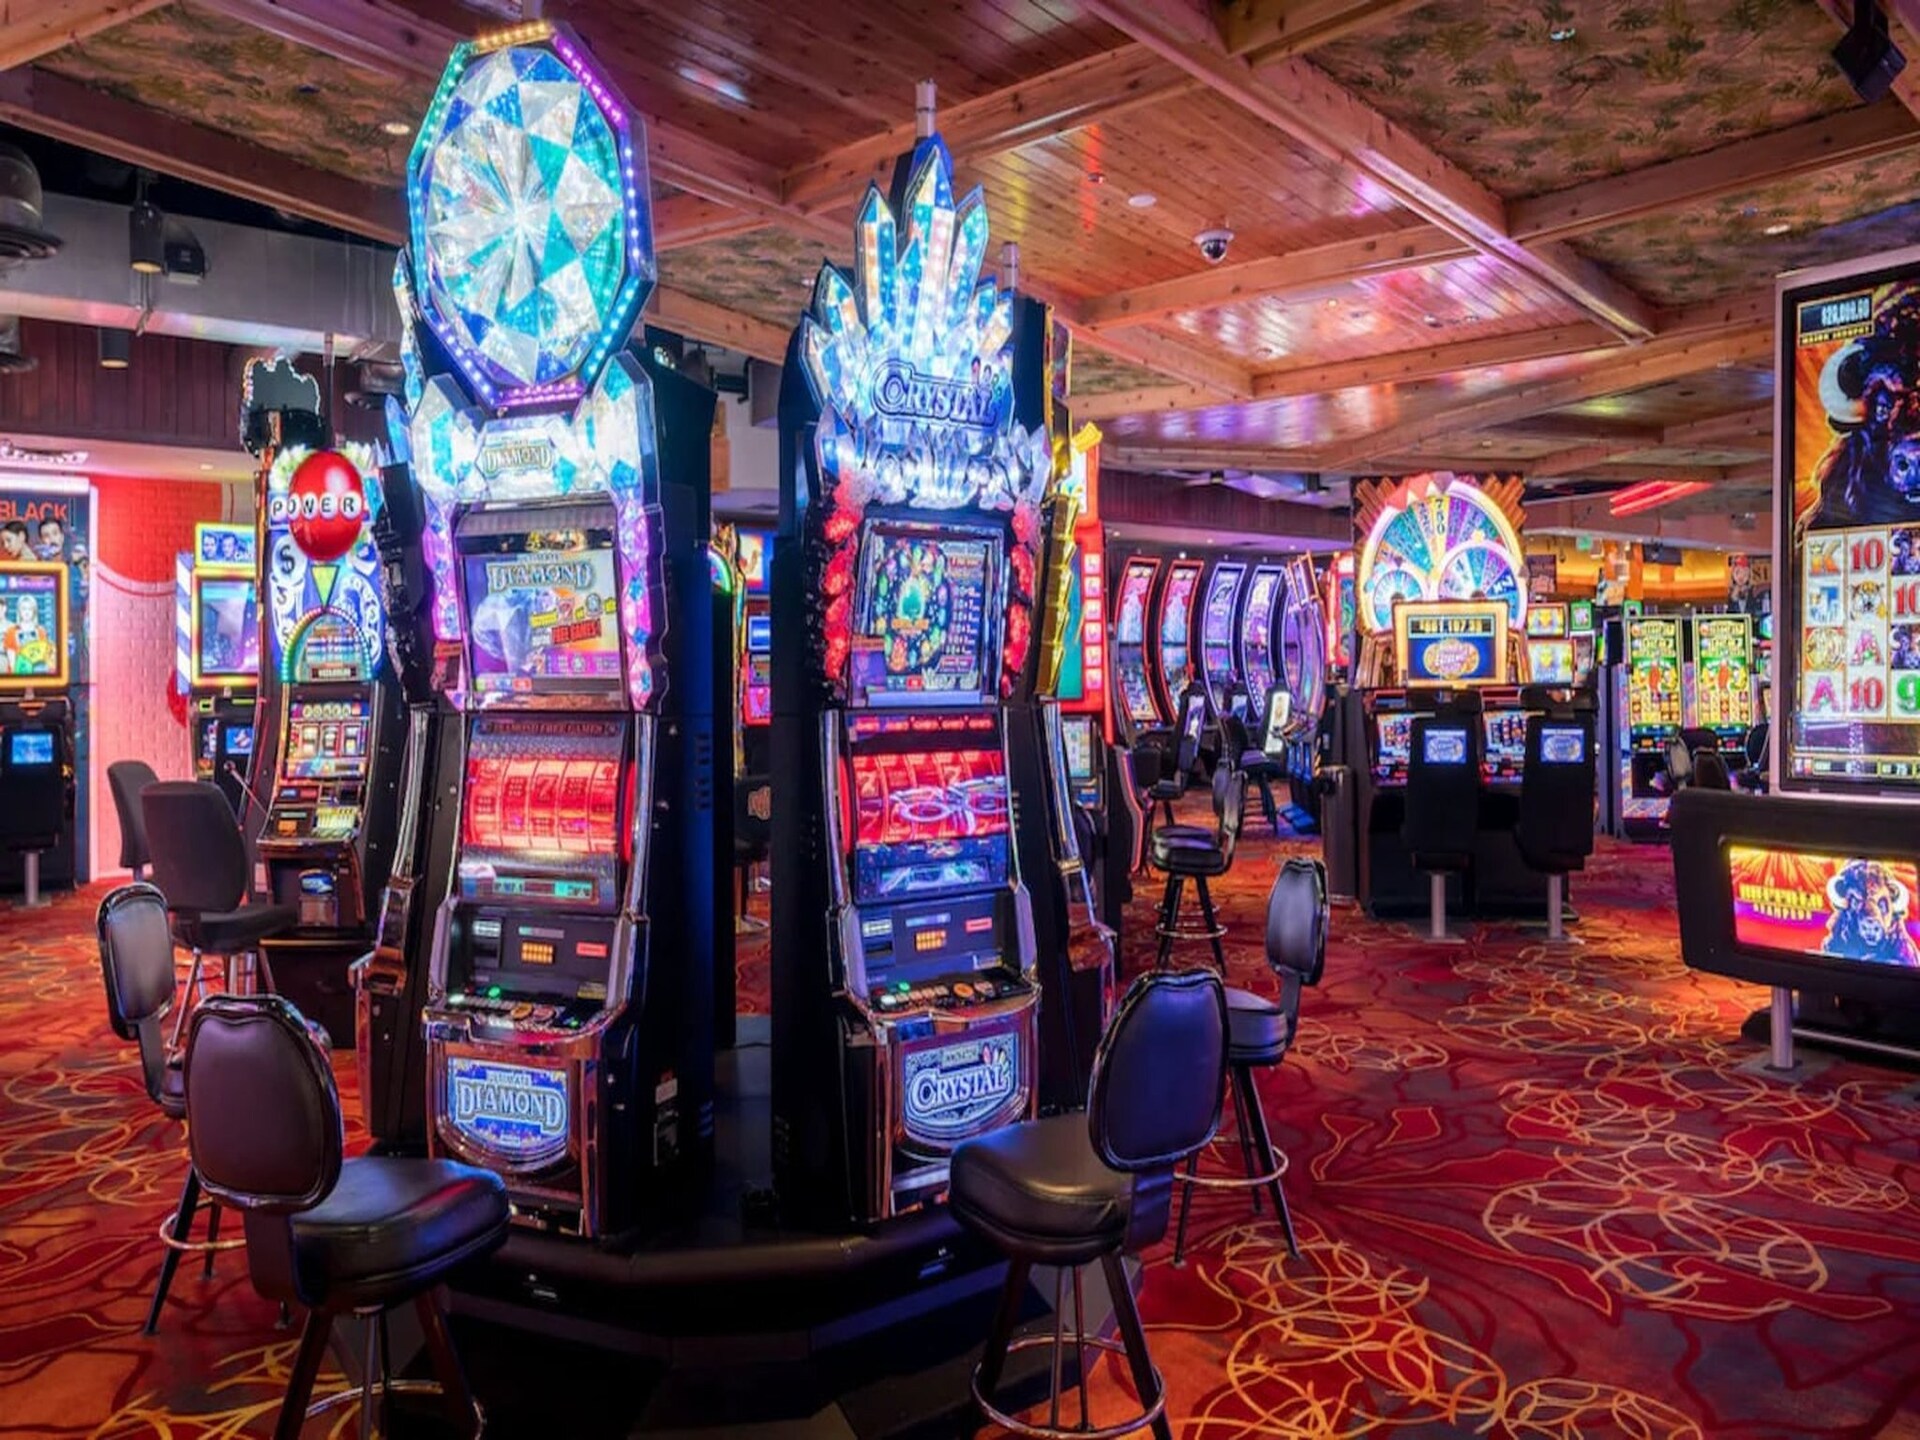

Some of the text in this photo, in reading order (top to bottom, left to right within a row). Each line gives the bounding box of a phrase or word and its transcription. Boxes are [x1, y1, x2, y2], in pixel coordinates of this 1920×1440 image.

[874, 361, 993, 424] CRYSTAL
[485, 447, 552, 474] DIAMOND
[0, 501, 67, 522] BLACK
[272, 494, 356, 516] POWER
[1851, 538, 1884, 571] 10
[489, 561, 594, 592] DIAMOND
[1808, 675, 1840, 711] A
[1850, 676, 1884, 711] 10
[911, 1064, 1007, 1111] CRYSTAL
[460, 1083, 562, 1127] DIAMOND
